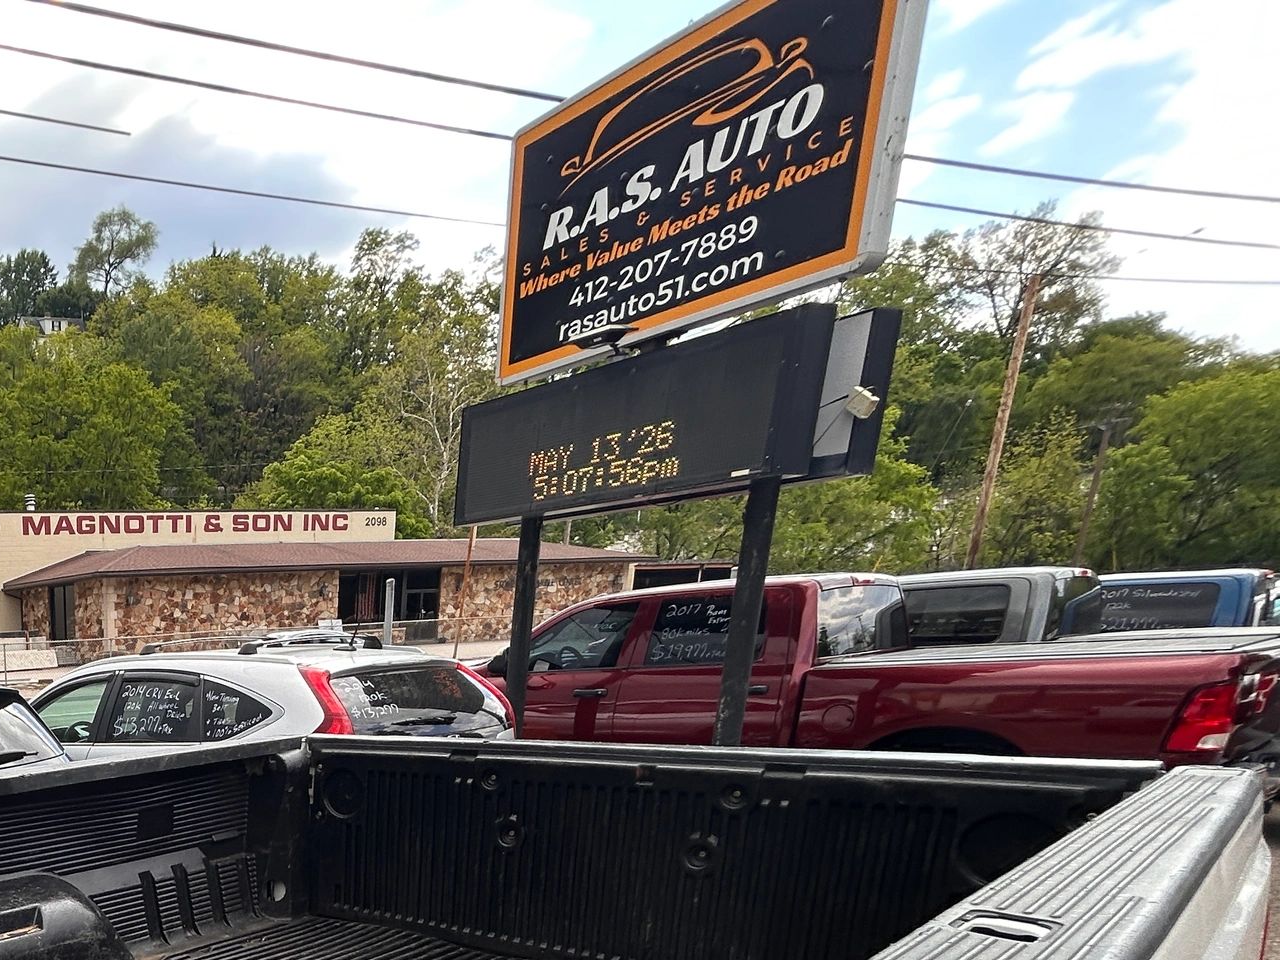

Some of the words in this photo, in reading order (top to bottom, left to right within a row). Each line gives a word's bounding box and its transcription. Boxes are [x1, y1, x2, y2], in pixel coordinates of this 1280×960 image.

[523, 228, 609, 277] SALES
[636, 212, 650, 225] &
[681, 116, 854, 207] SERVICE
[543, 164, 662, 250] R.A.S.
[669, 84, 824, 192] AUTO
[520, 256, 582, 299] Where
[586, 234, 643, 273] Value
[647, 205, 721, 247] Meets
[726, 184, 770, 213] the
[775, 139, 853, 194] Road
[568, 215, 759, 308] 412-207-7889
[558, 251, 764, 342] rasauto51.com
[529, 443, 574, 477] MAY
[21, 514, 192, 536] MAGNOTTI
[203, 514, 224, 532] &
[231, 514, 293, 532] SON
[303, 513, 349, 531] INC
[364, 516, 388, 528] 2098
[666, 603, 702, 618] 2017
